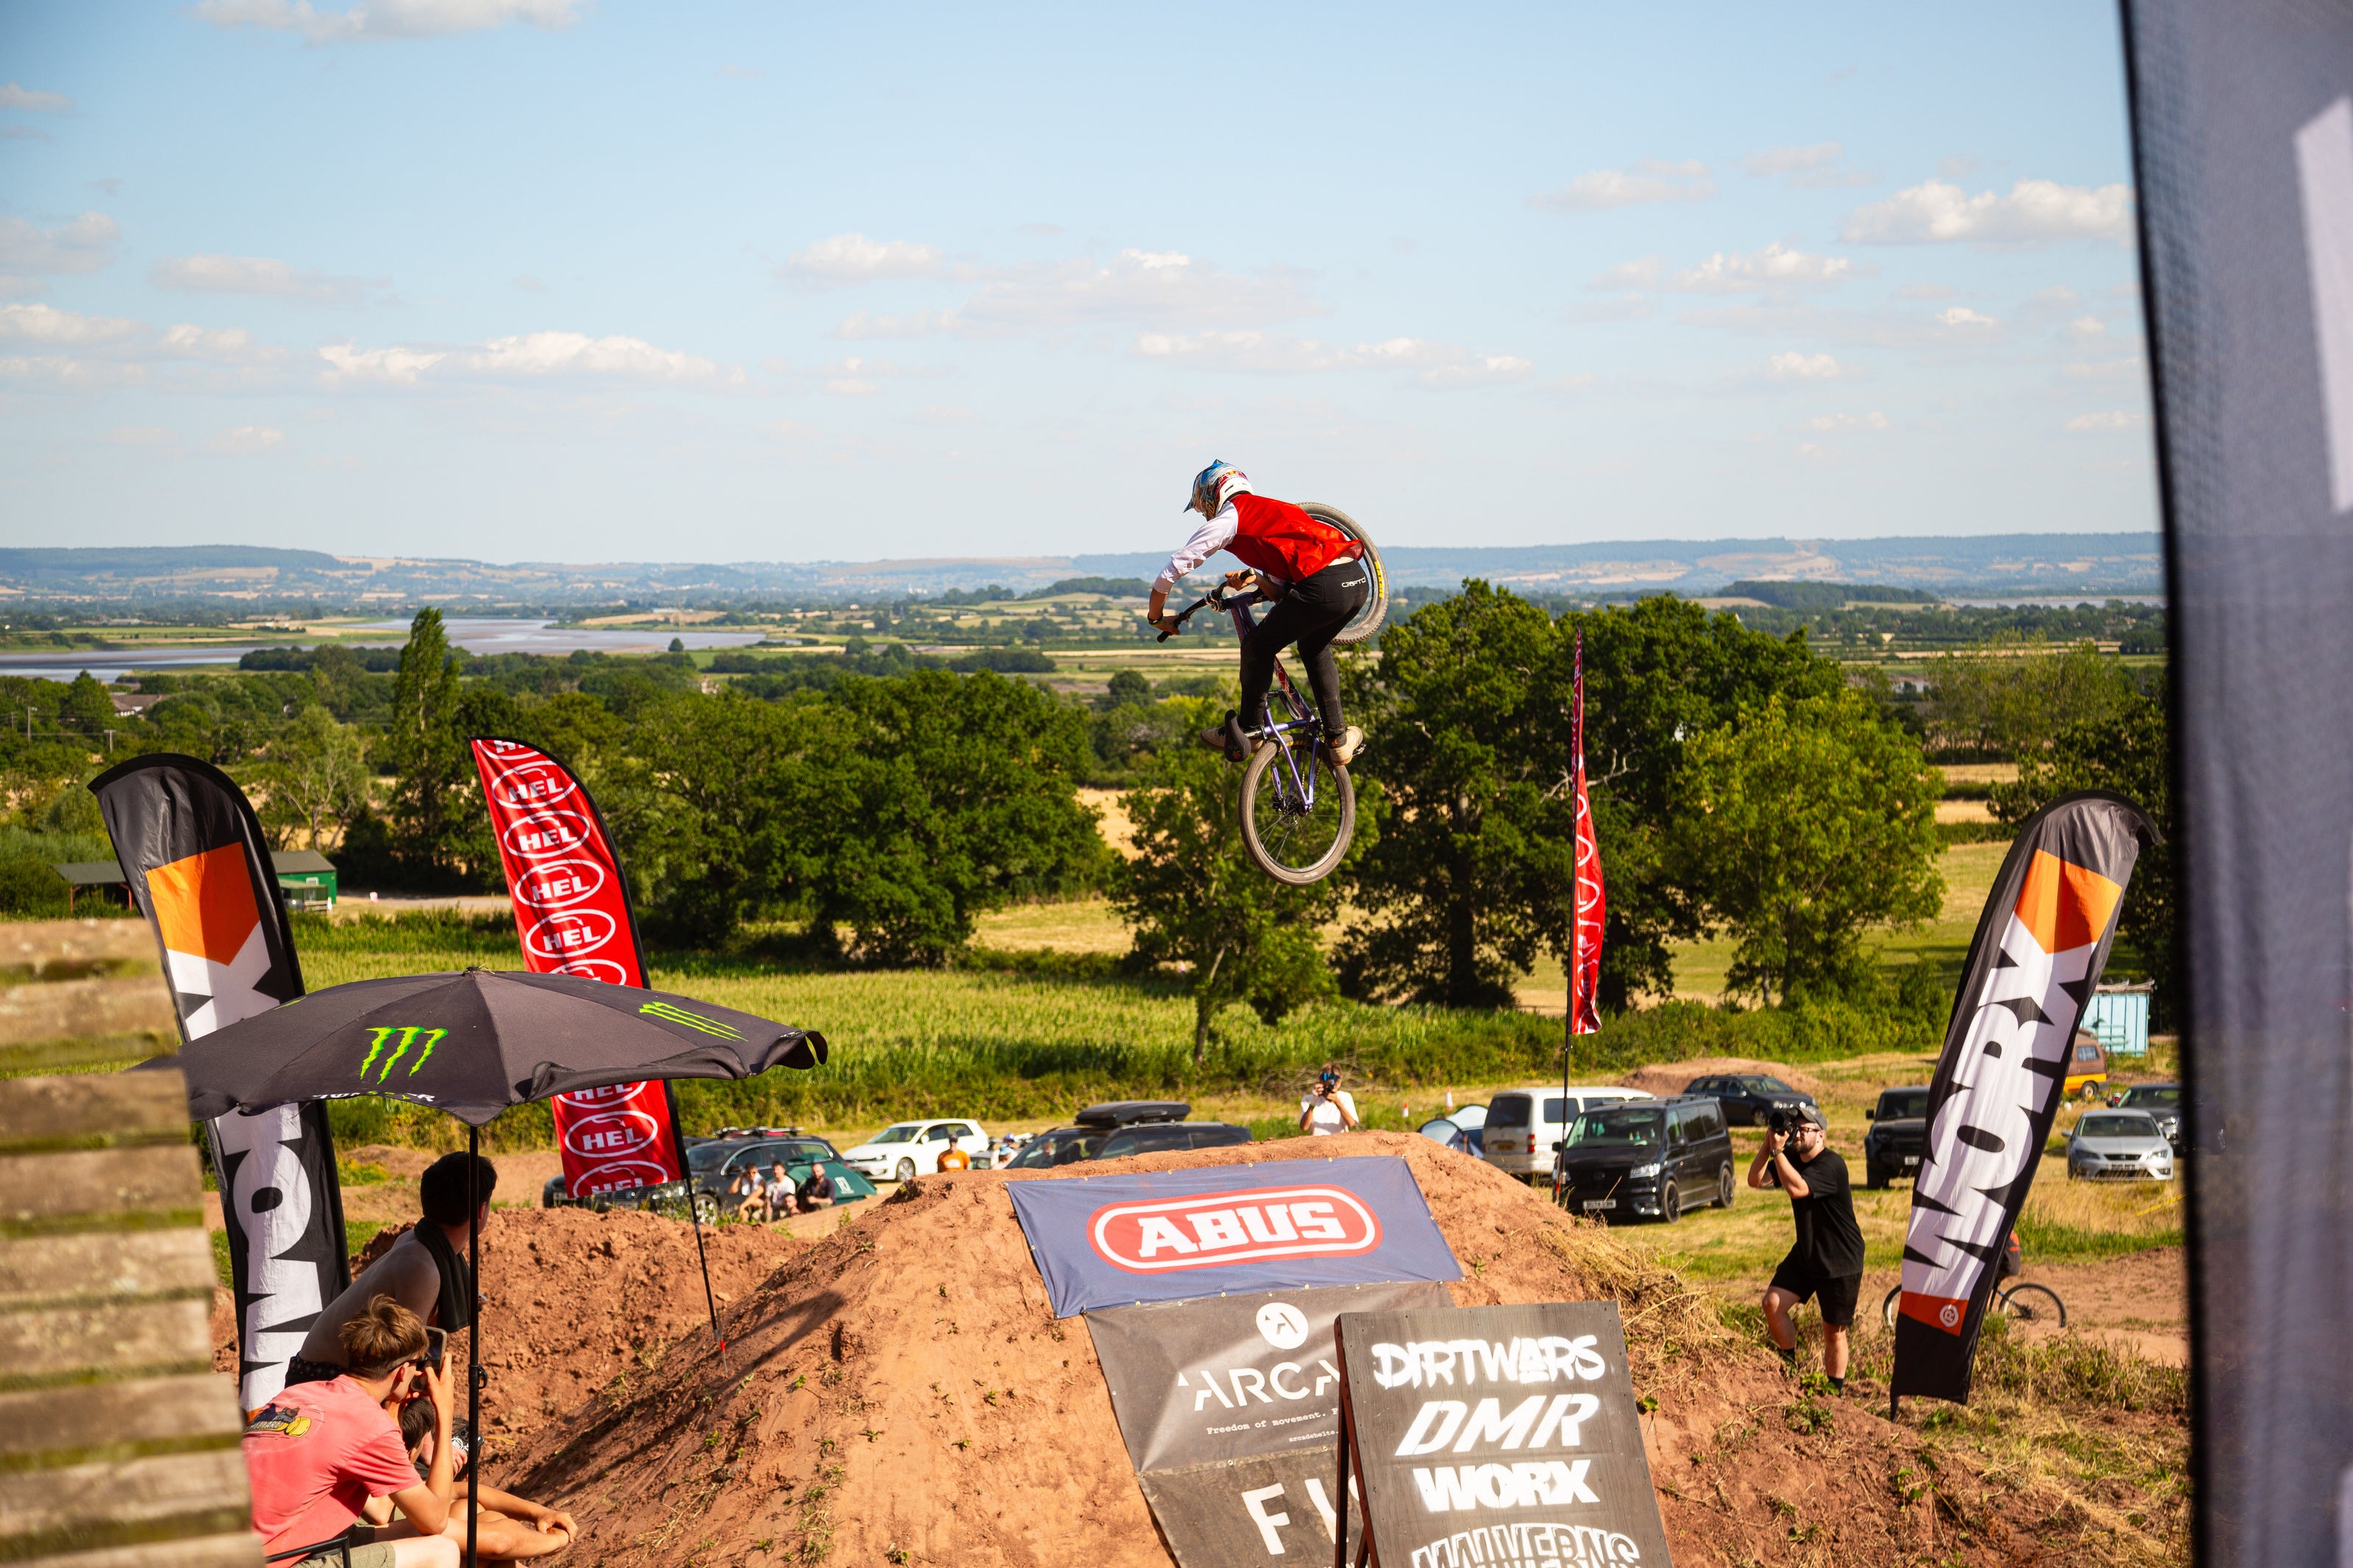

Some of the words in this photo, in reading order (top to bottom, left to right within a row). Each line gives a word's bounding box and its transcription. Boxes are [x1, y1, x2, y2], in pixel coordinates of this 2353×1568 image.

[507, 777, 564, 802] HEL
[518, 826, 578, 851] HEL
[531, 876, 590, 901] HEL
[542, 926, 601, 952] HEL
[1902, 912, 2096, 1300] WORX
[582, 1128, 643, 1151] HEL
[1138, 1202, 1346, 1258] ABUS
[1207, 1423, 1251, 1435] Freedom
[1254, 1420, 1267, 1428] of
[1272, 1411, 1327, 1426] movement.
[1394, 1394, 1600, 1456] DMR
[1413, 1459, 1601, 1513] WORX
